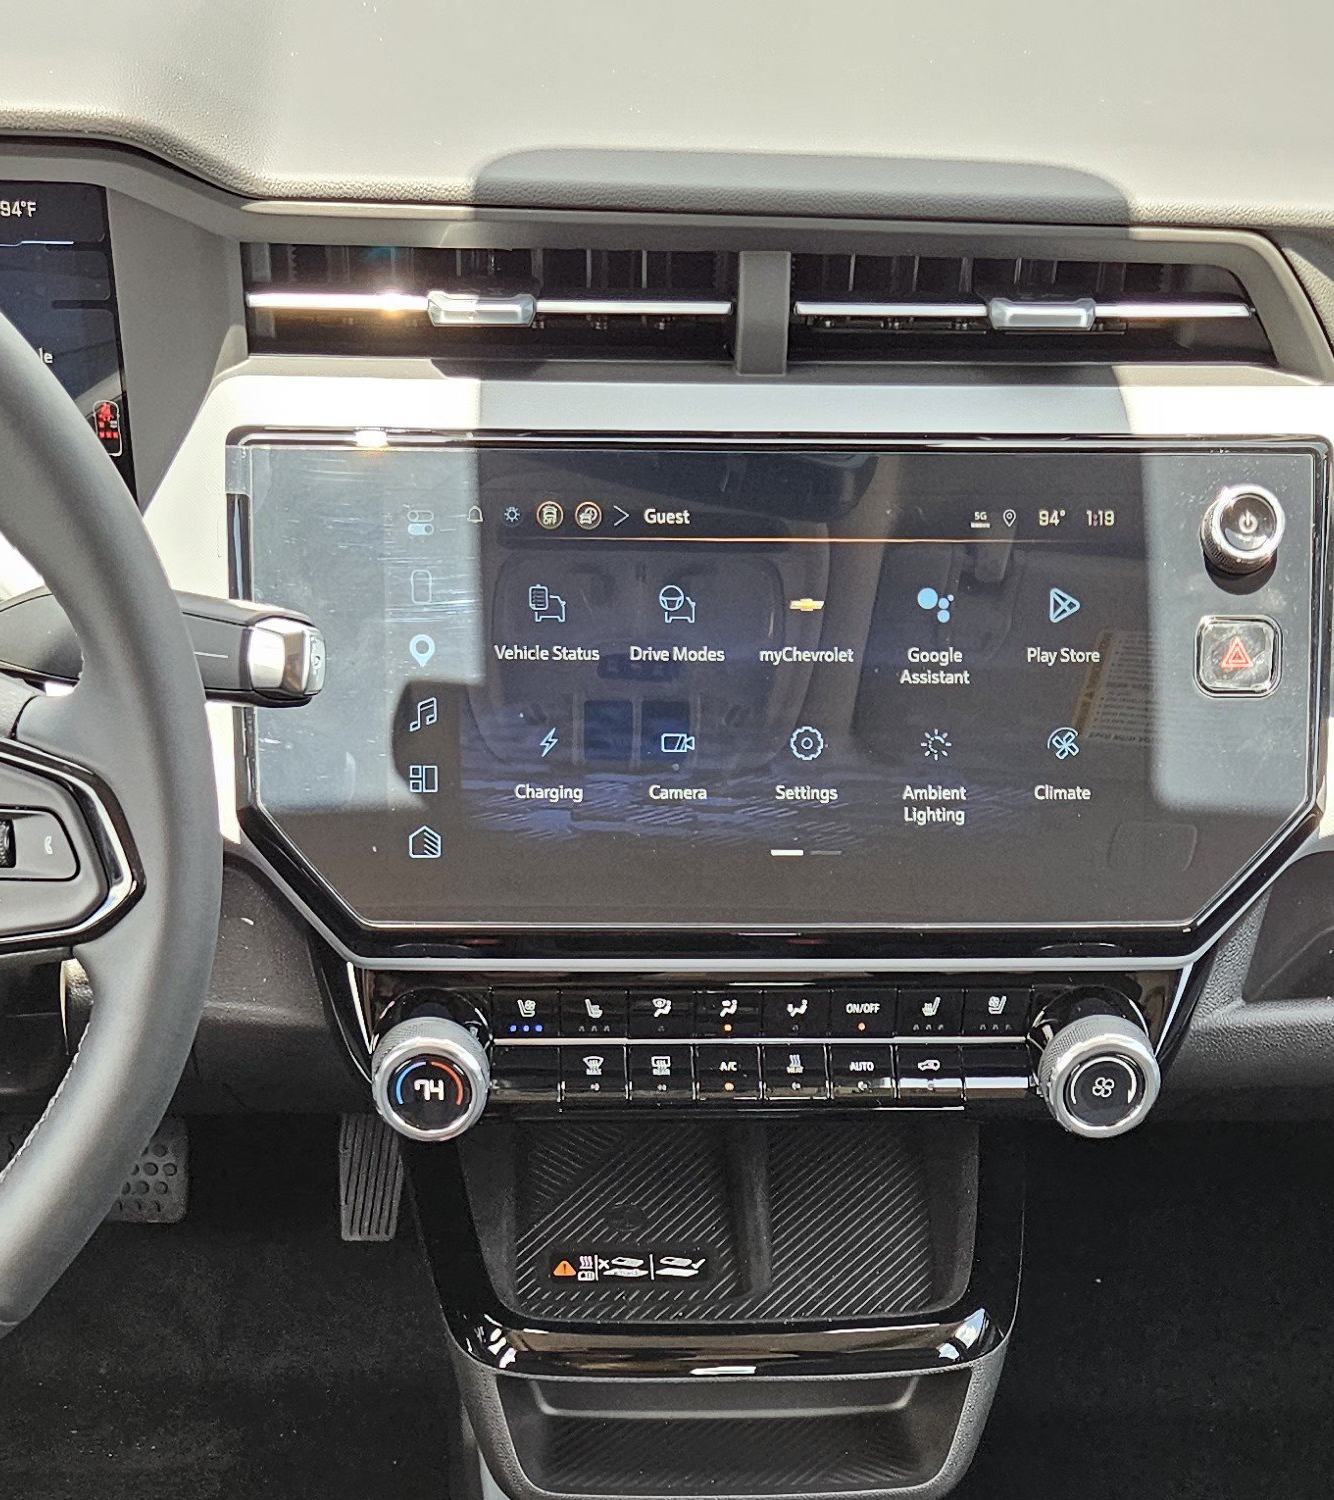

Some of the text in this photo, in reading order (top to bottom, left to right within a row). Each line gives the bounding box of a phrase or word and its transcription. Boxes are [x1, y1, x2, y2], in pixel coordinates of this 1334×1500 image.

[0, 200, 38, 217] 94°F
[643, 508, 691, 525] Guest
[974, 509, 1115, 527] 5G 94° 1:19
[493, 644, 600, 662] Vehicle Status
[629, 645, 726, 662] Drive Modes
[759, 647, 854, 666] myChevrolet
[907, 648, 963, 666] Google
[1027, 648, 1100, 667] Play Store
[900, 669, 970, 685] Assistant
[514, 784, 584, 803] Charging
[649, 785, 707, 800] Camera
[775, 785, 839, 804] Settings
[902, 785, 967, 801] Ambient
[1034, 785, 1091, 800] Climate
[903, 807, 965, 826] Lighting
[846, 1003, 881, 1014] ON/OFF
[720, 1062, 738, 1072] A/C
[849, 1061, 875, 1072] AUTO
[413, 1078, 445, 1101] 74
